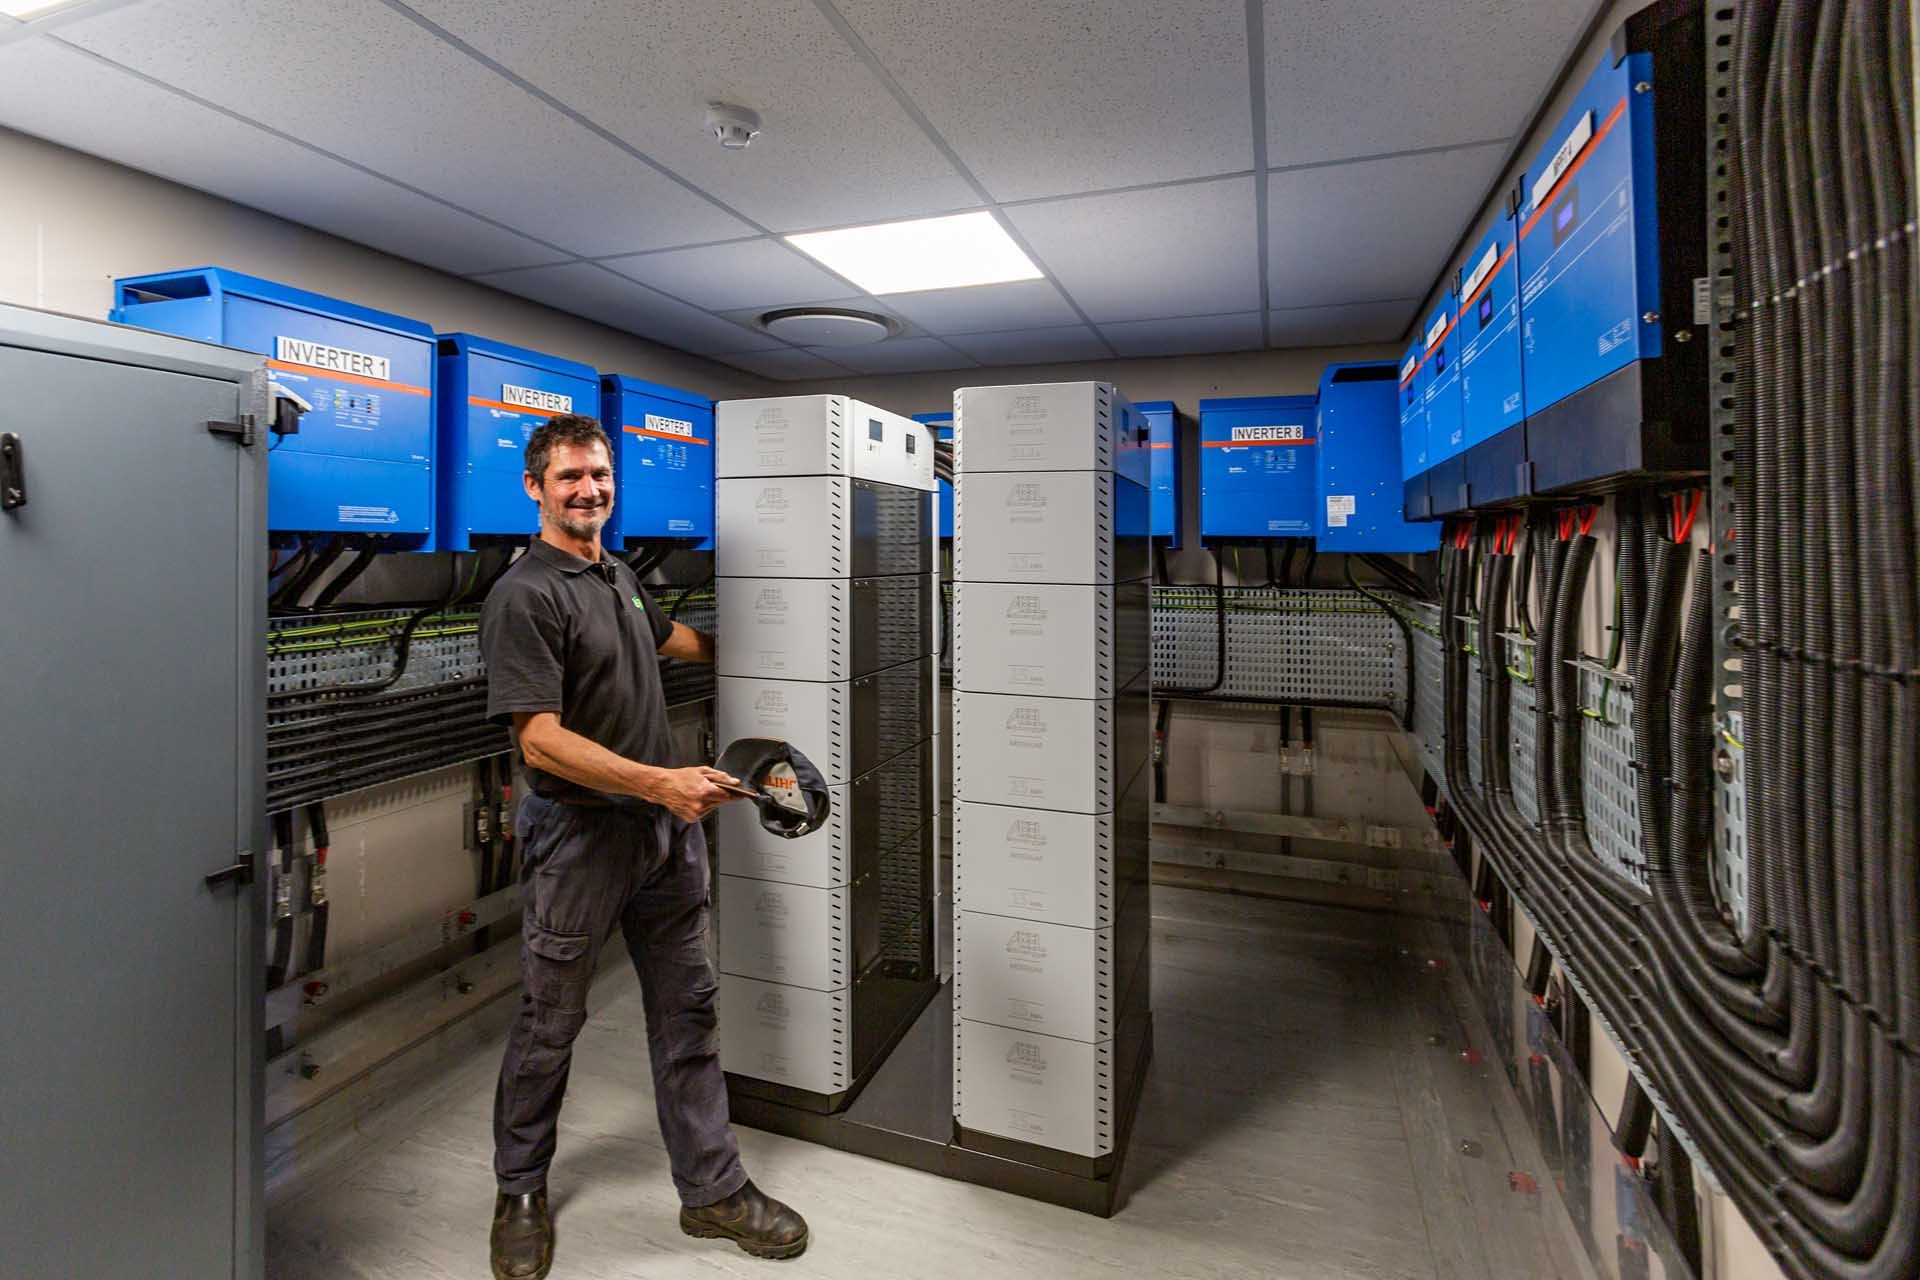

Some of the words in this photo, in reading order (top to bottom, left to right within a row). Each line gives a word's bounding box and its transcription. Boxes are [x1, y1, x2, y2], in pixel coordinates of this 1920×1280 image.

[283, 339, 374, 375] INVERTER
[380, 359, 387, 377] 1
[505, 386, 561, 410] INVERTER
[563, 397, 570, 412] 2
[647, 415, 685, 434] INVERTER
[1233, 427, 1292, 439] INVERTER
[1295, 426, 1302, 439] 8
